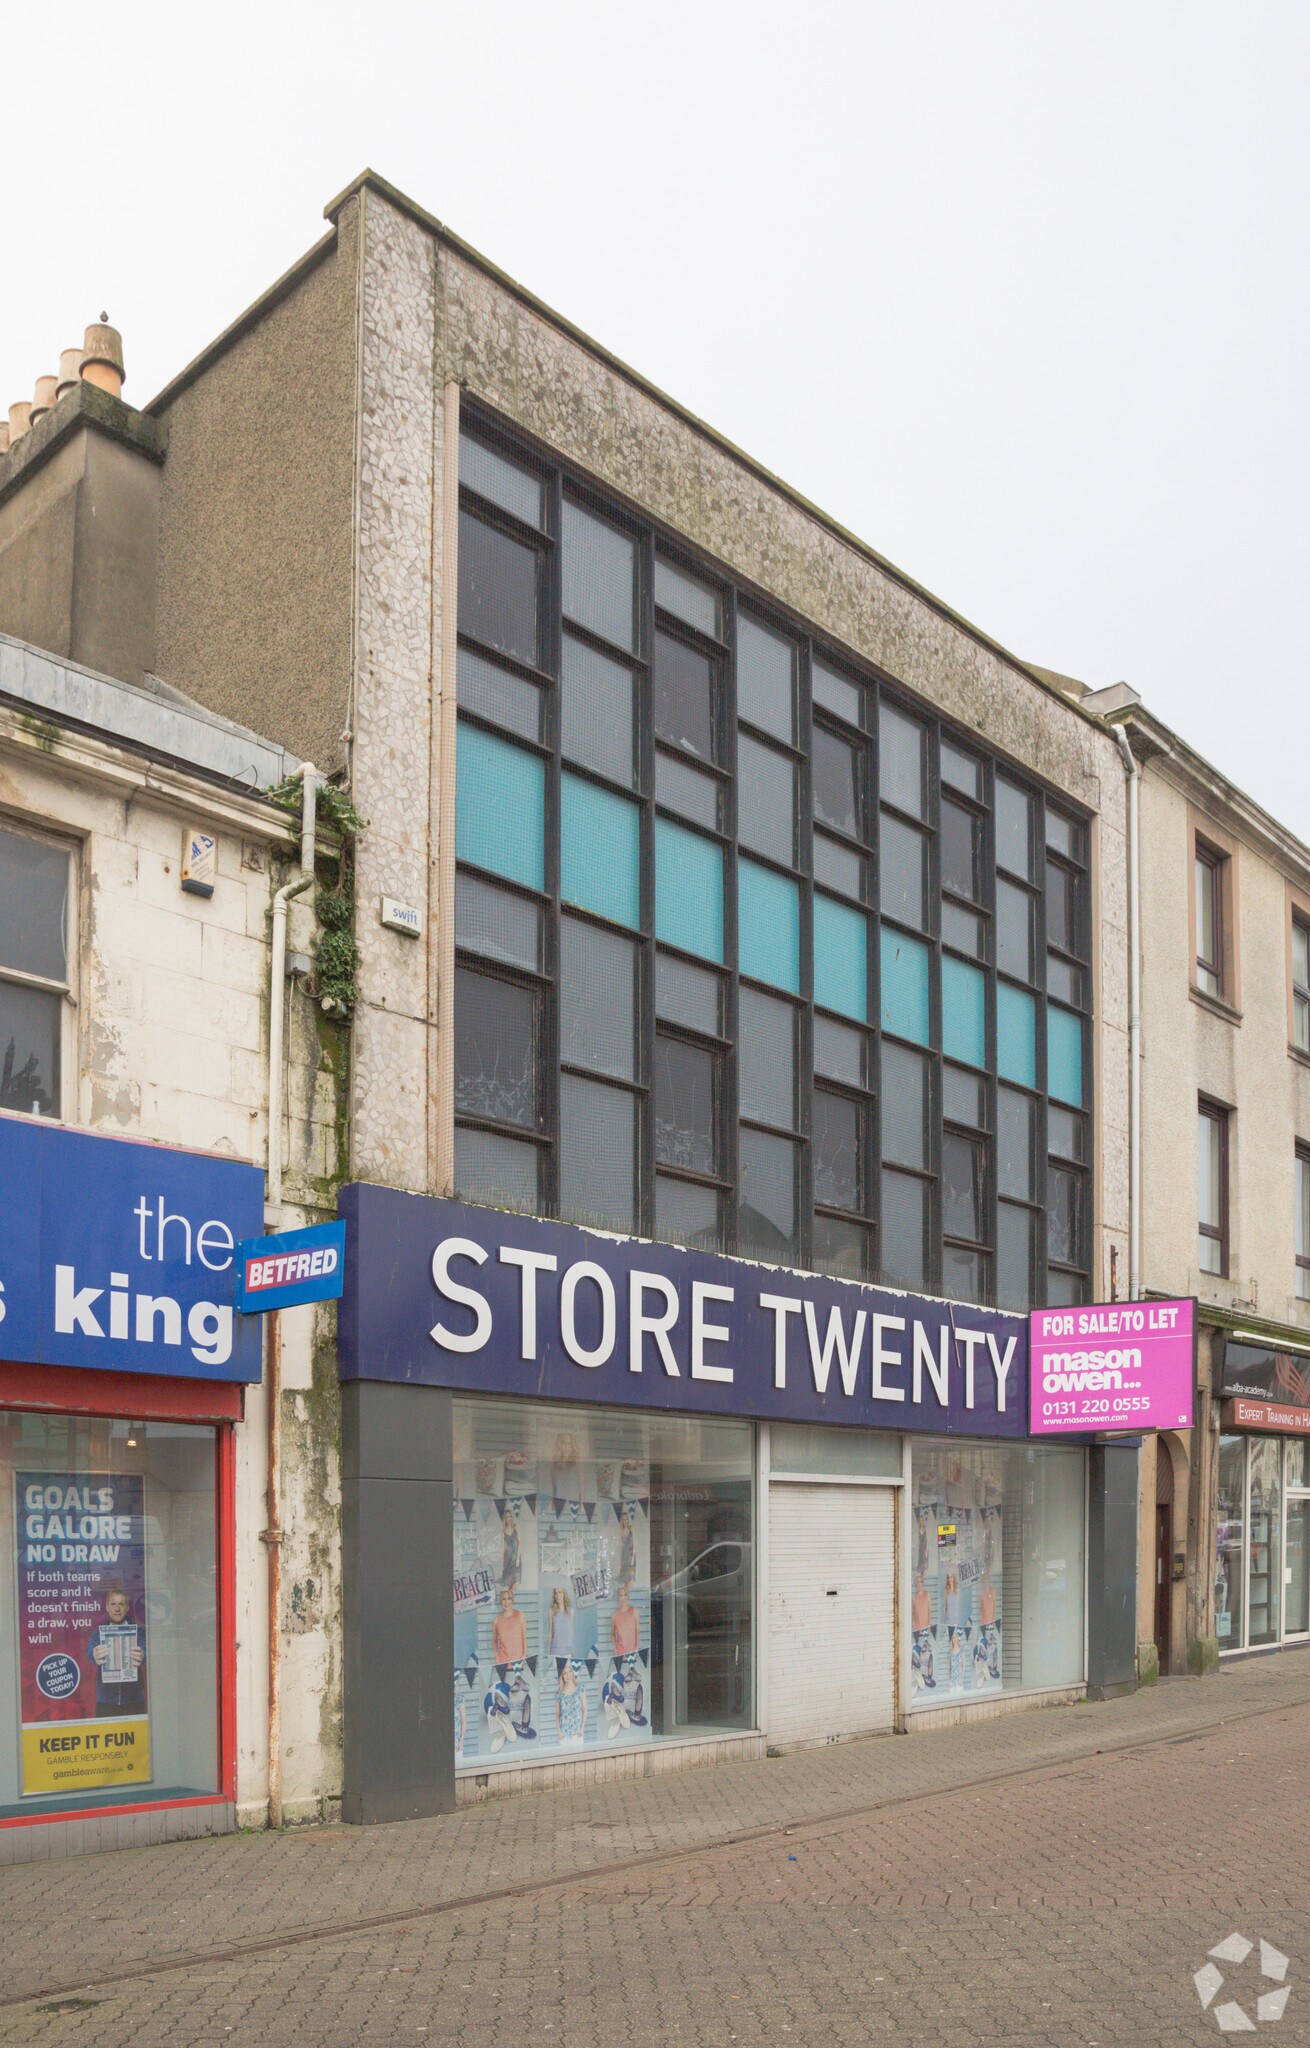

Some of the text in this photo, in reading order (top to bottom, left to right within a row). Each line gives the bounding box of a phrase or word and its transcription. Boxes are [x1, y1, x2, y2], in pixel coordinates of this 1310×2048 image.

[392, 907, 418, 926] swift
[133, 1195, 234, 1271] the
[248, 1248, 338, 1288] BETFRED
[55, 1264, 234, 1365] king
[1042, 1308, 1179, 1337] FOR SALE/TO LET
[430, 1237, 1017, 1412] STORE TWENTY
[1042, 1348, 1142, 1373] mason
[1042, 1397, 1150, 1416] 0131 220 0555
[1042, 1413, 1128, 1426] www.masonowen.com
[25, 1485, 114, 1512] GOALS
[26, 1515, 131, 1540] GALORE
[27, 1545, 58, 1563] NO
[61, 1545, 120, 1563] DRAW
[27, 1571, 101, 1582] If both teams
[453, 1570, 491, 1601] BEACH
[27, 1586, 92, 1598] score and it
[27, 1601, 101, 1613] doesn't finish
[28, 1620, 34, 1629] a
[37, 1617, 68, 1630] draw,
[71, 1618, 92, 1631] you
[28, 1633, 52, 1644] win!
[42, 1658, 68, 1672] PICK UP
[48, 1667, 67, 1678] YOUR
[46, 1673, 73, 1687] COUPON
[49, 1681, 75, 1694] TODAY!
[39, 1731, 135, 1753] KEEP IT FUN
[47, 1750, 129, 1765] GAMBLE RESPONSIBLY
